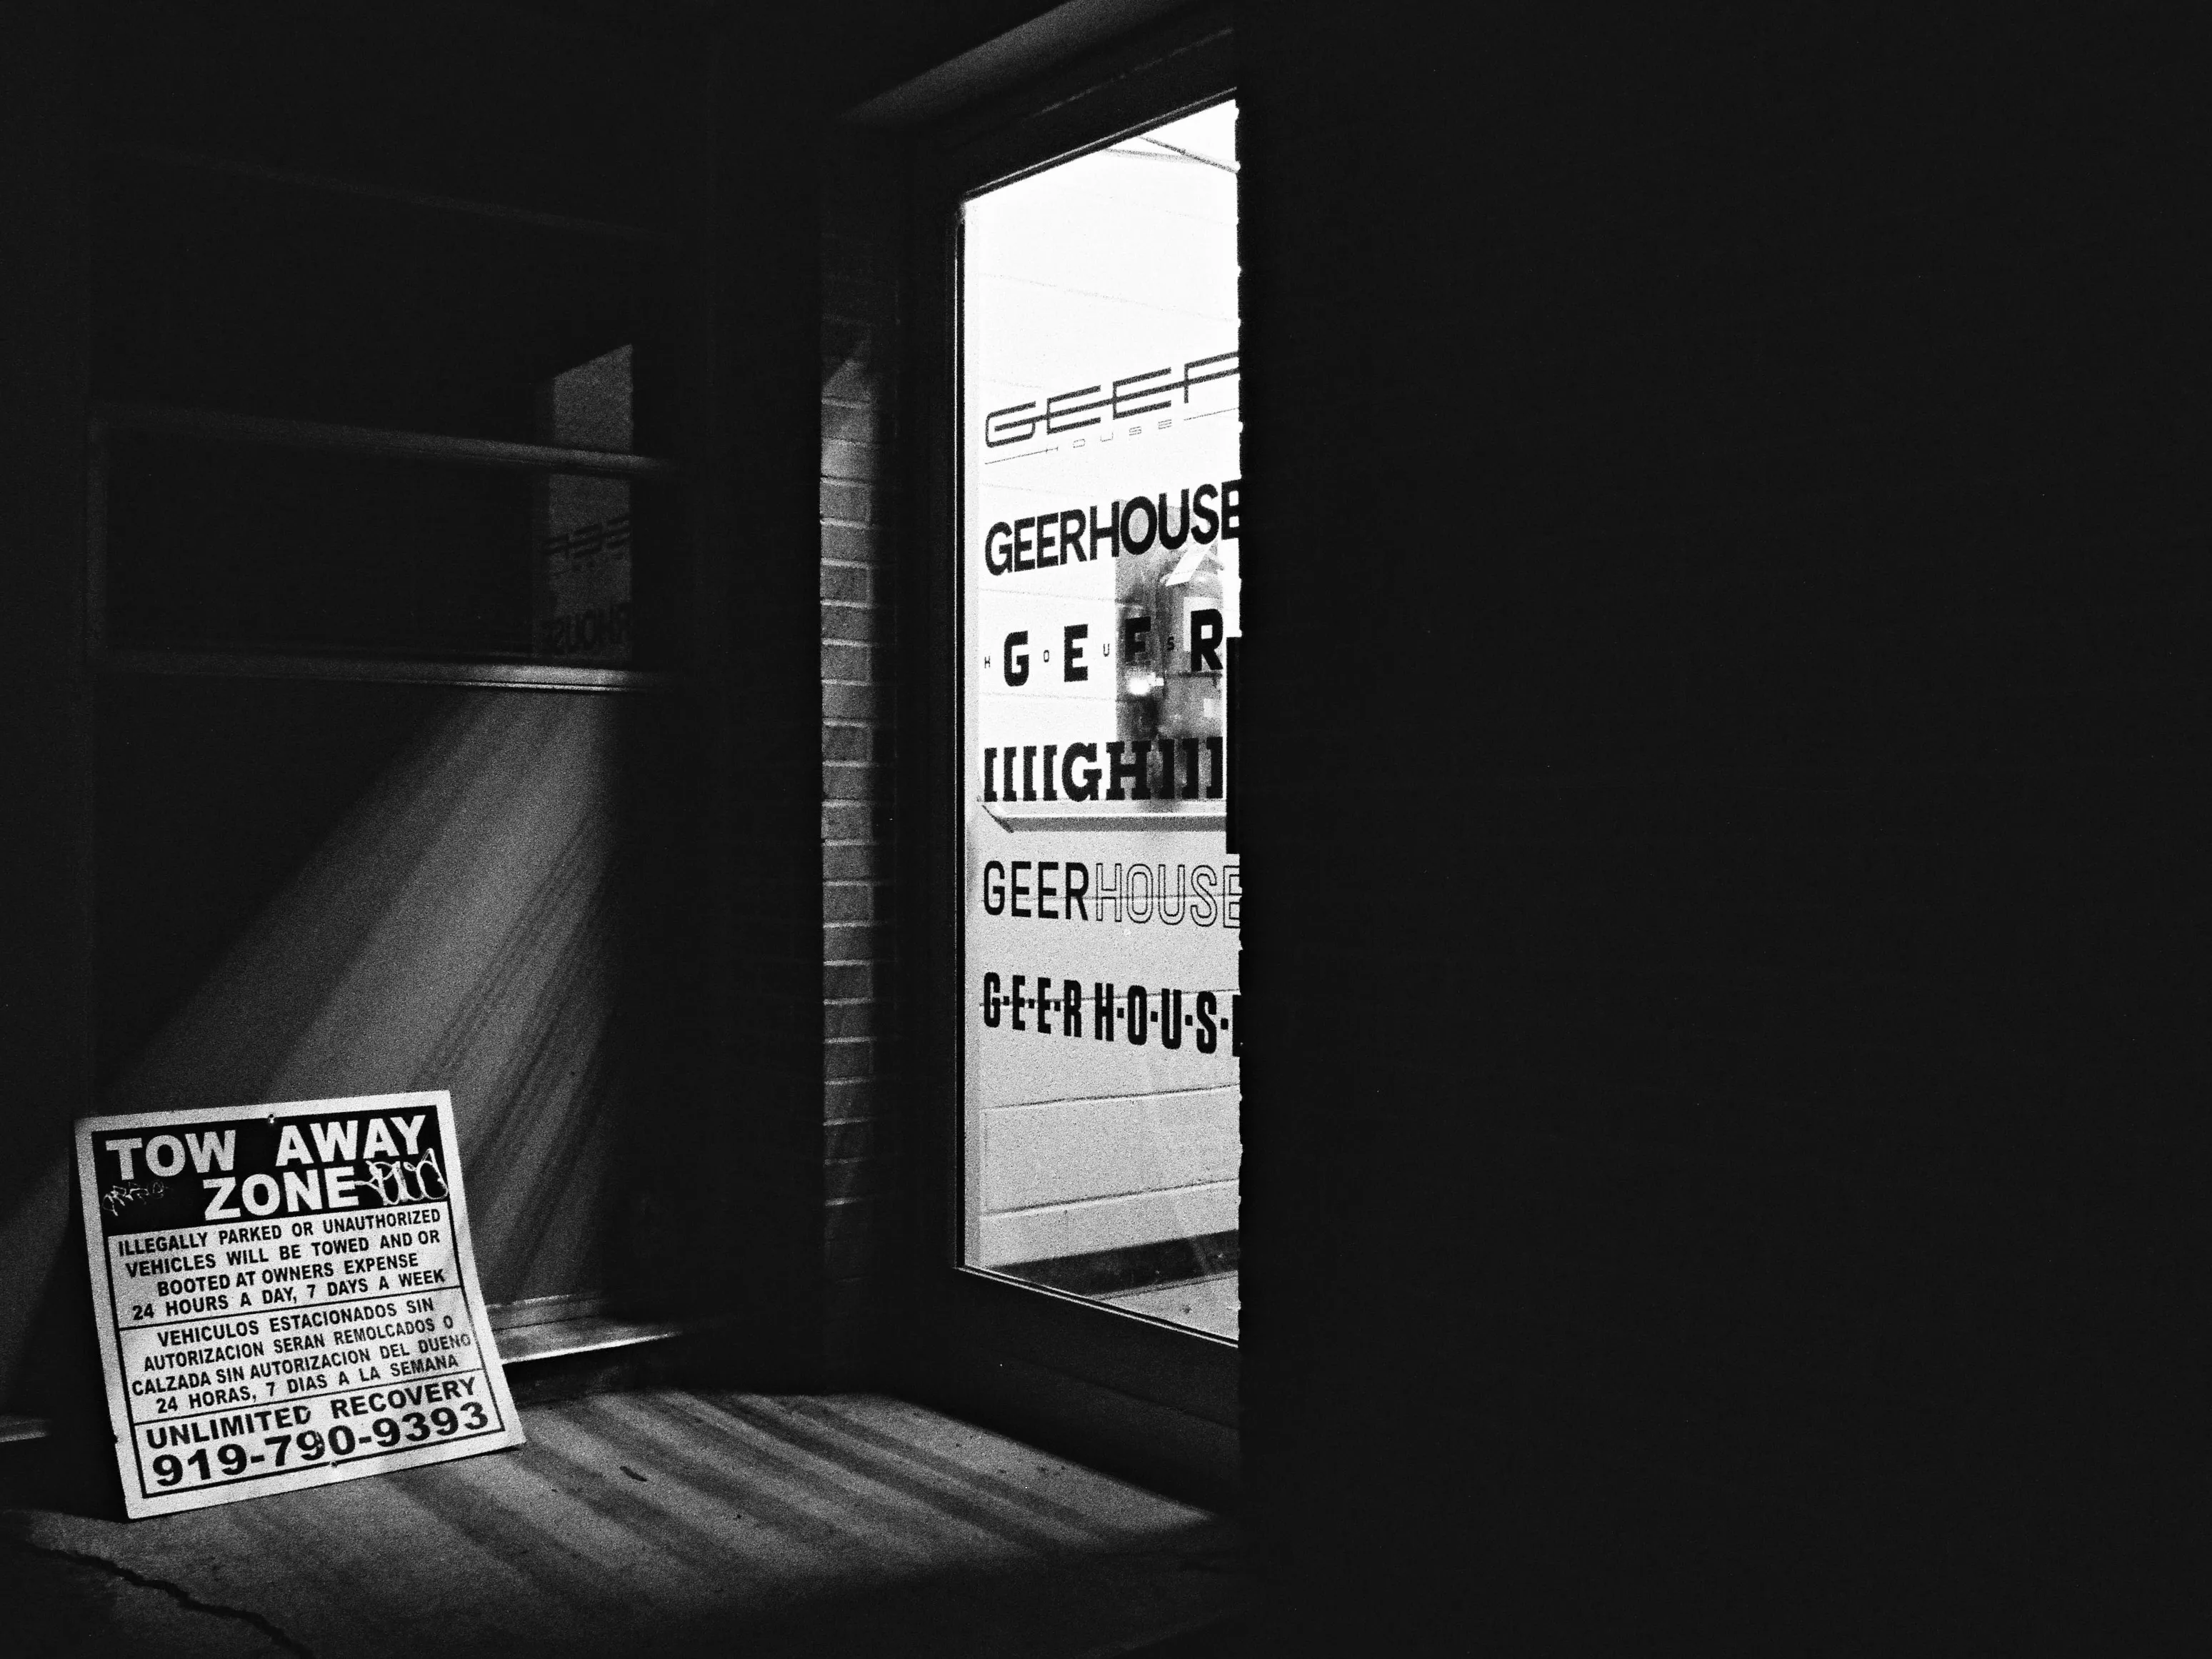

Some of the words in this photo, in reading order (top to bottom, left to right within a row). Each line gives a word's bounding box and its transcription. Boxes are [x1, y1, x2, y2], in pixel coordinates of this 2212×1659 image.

[984, 860, 1241, 928] GEERHOUSE
[106, 1129, 236, 1181] TOW
[276, 1115, 426, 1166] AWAY
[203, 1166, 359, 1221] ZONE
[119, 1232, 208, 1257] ILLEGALLY
[219, 1225, 282, 1245] PARKED
[291, 1221, 314, 1237] OR
[323, 1208, 441, 1233] UNAUTHORIZED
[125, 1253, 216, 1278] VEHICLES
[226, 1248, 269, 1265] WILL
[279, 1244, 301, 1260] BE
[311, 1237, 369, 1256] TOWED
[380, 1232, 413, 1248] AND
[418, 1230, 440, 1245] OR
[132, 1303, 154, 1320] 24
[166, 1294, 229, 1316] HOURS
[240, 1292, 251, 1308] A
[261, 1287, 297, 1304] DAY,
[306, 1284, 316, 1298] 7
[327, 1278, 369, 1296] DAYS
[379, 1275, 389, 1291] A
[399, 1268, 446, 1287] WEEK
[158, 1274, 230, 1296] BOOTED
[236, 1271, 256, 1288] AT
[261, 1262, 334, 1283] OWNERS
[344, 1253, 419, 1274] EXPENSE
[144, 1341, 264, 1372] AUTORIZACION
[274, 1333, 325, 1353] SERAN
[334, 1318, 435, 1345] REMOLCADOS
[443, 1315, 454, 1329] O
[157, 1320, 259, 1347] VEHICULOS
[269, 1303, 397, 1333] ESTACIONADOS
[406, 1298, 434, 1313] SIN
[131, 1371, 211, 1397] CALZADA
[216, 1365, 245, 1384] SIN
[250, 1348, 371, 1380] AUTORIZACION
[379, 1343, 410, 1359] DEL
[417, 1333, 471, 1353] DUENO
[156, 1396, 178, 1414] 24
[189, 1385, 256, 1409] HORAS,
[266, 1381, 275, 1397] 7
[286, 1374, 328, 1394] DIAS
[339, 1371, 350, 1385] A
[359, 1366, 381, 1382] LA
[390, 1354, 459, 1377] SEMANA
[146, 1405, 311, 1449] UNLIMITED
[330, 1376, 476, 1419] RECOVERY
[153, 1402, 489, 1486] 919-790-9393
